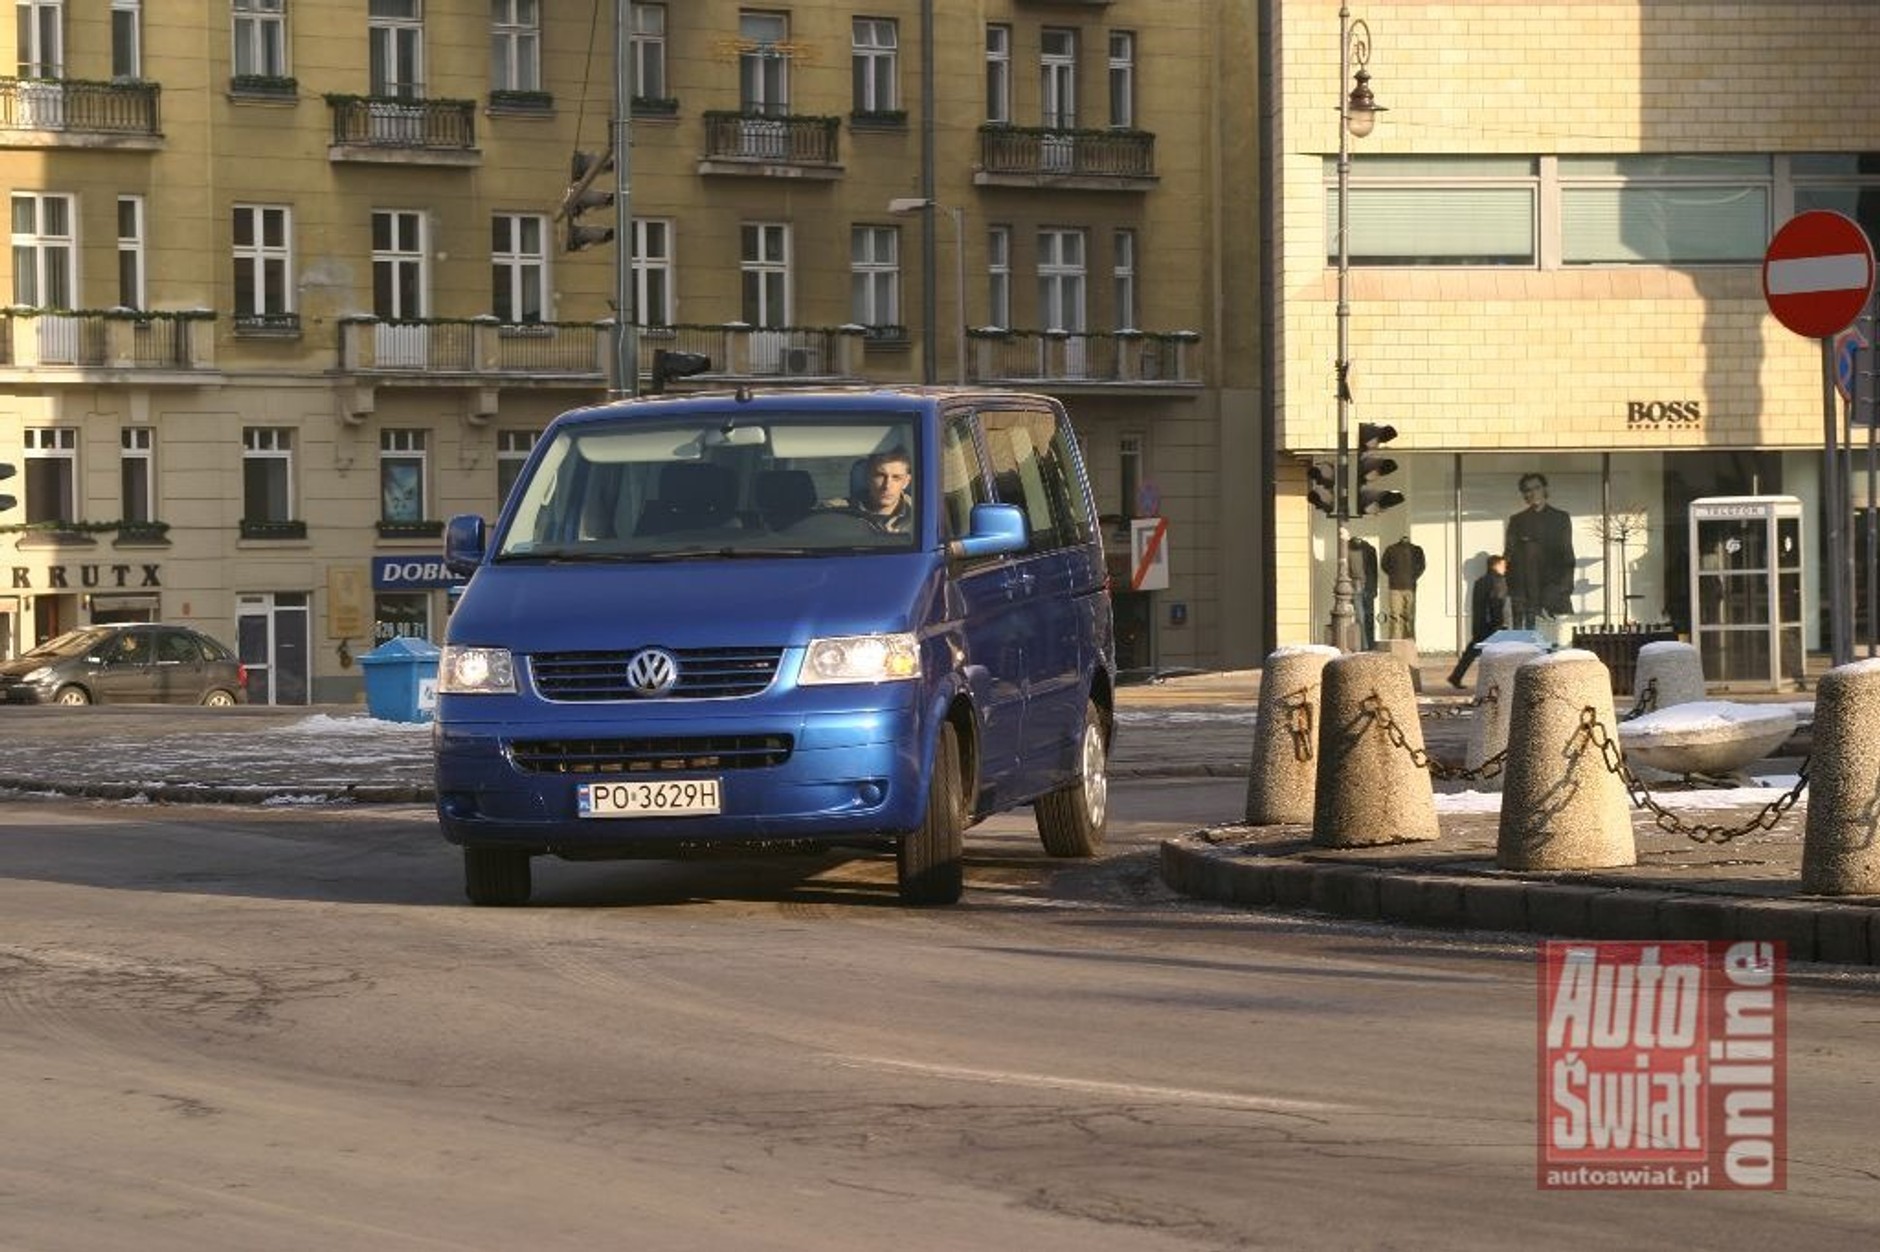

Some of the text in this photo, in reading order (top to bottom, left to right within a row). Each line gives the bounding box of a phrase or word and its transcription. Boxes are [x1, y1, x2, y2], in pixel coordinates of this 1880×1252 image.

[1628, 401, 1700, 423] BOSS
[594, 785, 629, 809] PO
[638, 783, 716, 808] 3629H
